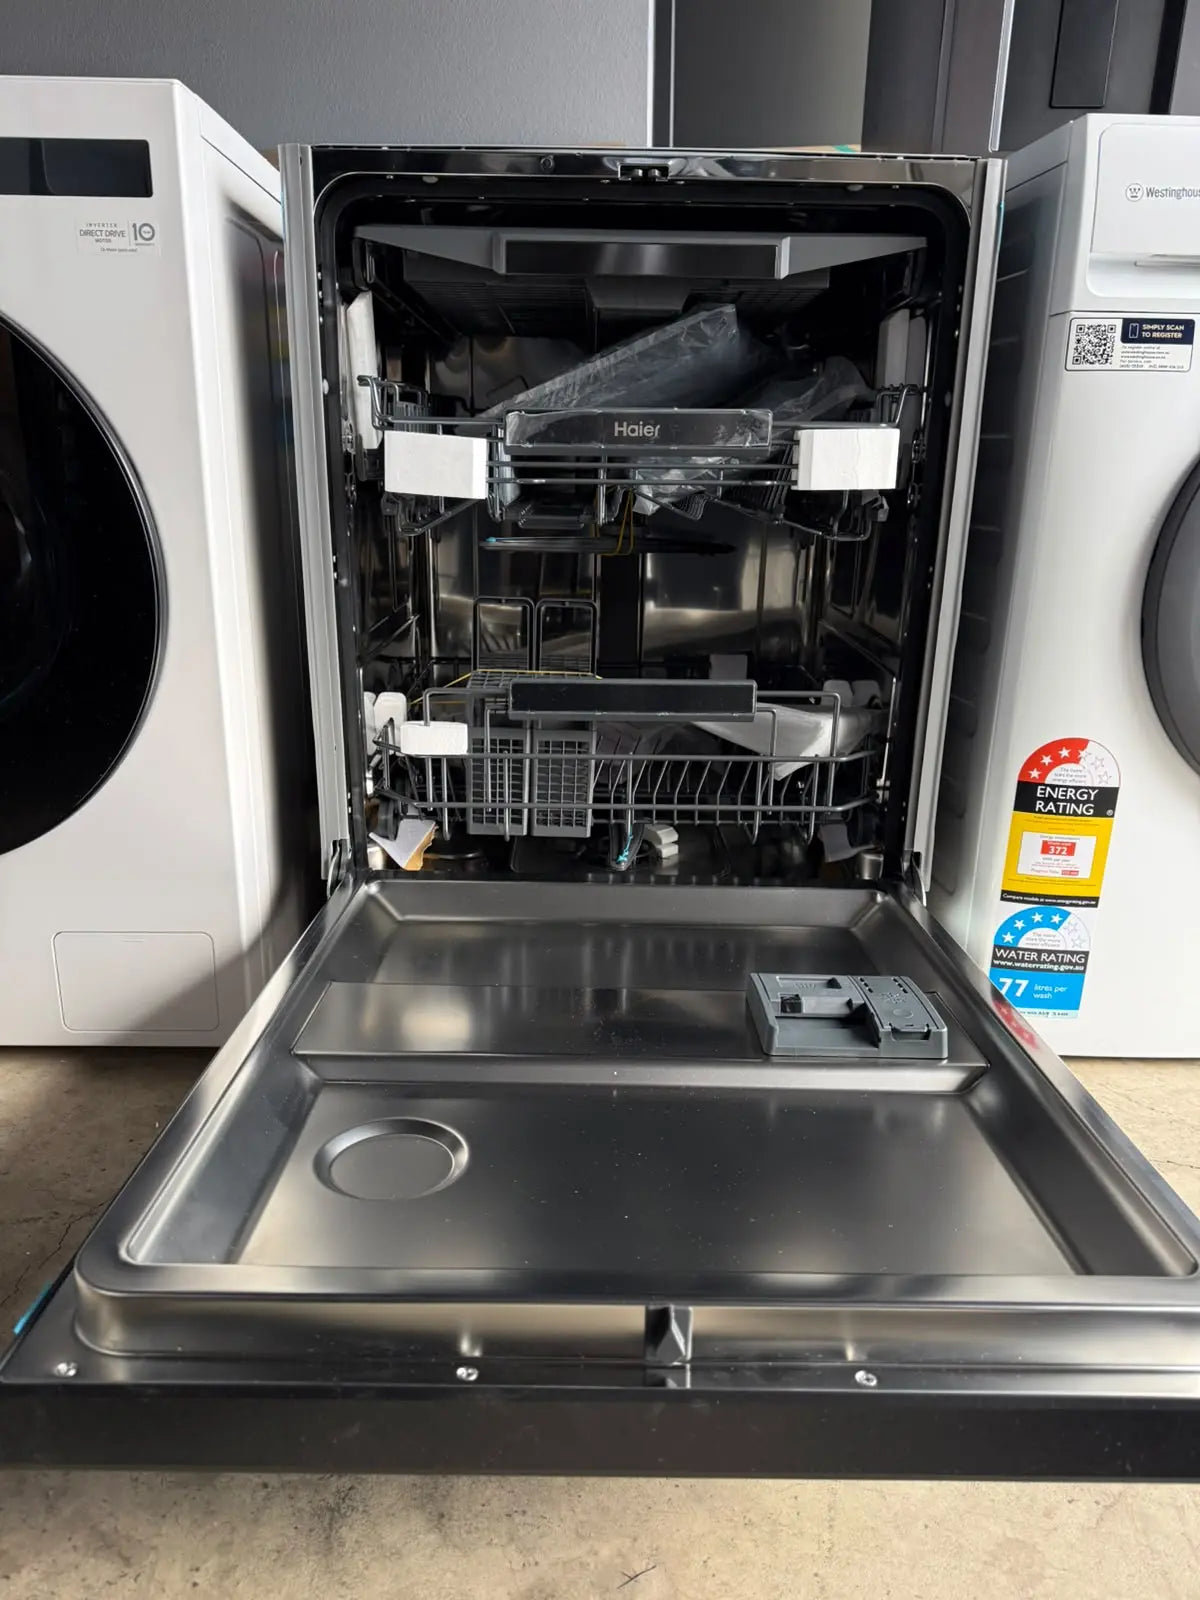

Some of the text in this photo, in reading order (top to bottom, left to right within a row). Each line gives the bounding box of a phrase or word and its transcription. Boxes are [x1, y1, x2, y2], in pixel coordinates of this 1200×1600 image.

[79, 229, 126, 238] DIRECT DRIVE
[132, 222, 155, 242] 10
[614, 420, 660, 437] Haier
[1036, 785, 1099, 801] ENERGY
[1035, 800, 1095, 816] RATING
[1048, 846, 1068, 856] 372
[994, 948, 1086, 964] WATER RATING
[993, 960, 1085, 971] www.waterrating.gov.au
[999, 977, 1029, 998] 77
